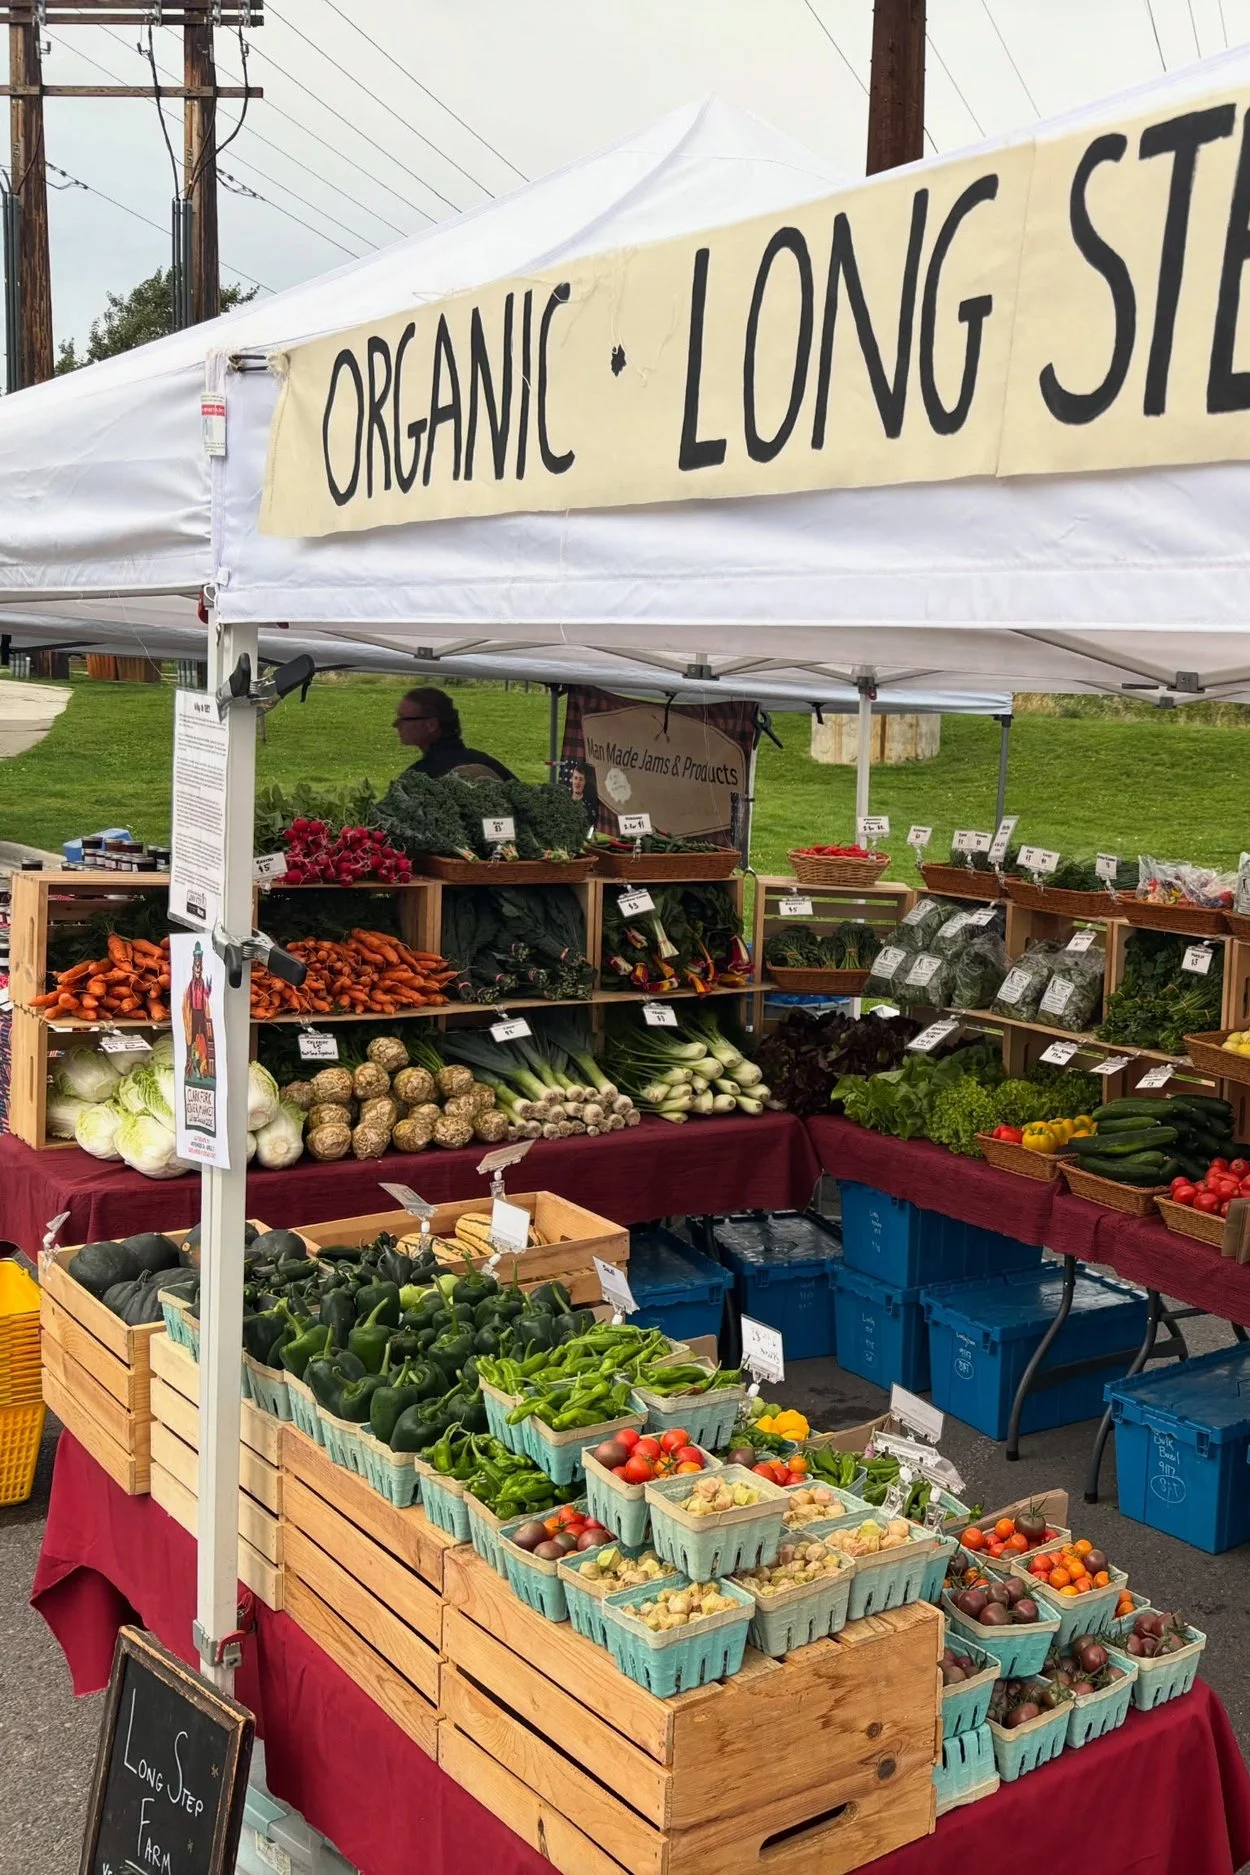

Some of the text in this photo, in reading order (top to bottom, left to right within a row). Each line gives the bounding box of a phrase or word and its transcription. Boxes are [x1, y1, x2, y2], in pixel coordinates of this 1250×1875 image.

[322, 281, 575, 506] ORGANIC
[679, 173, 1000, 471] LONG
[586, 737, 739, 786] Man Made Jams & Products
